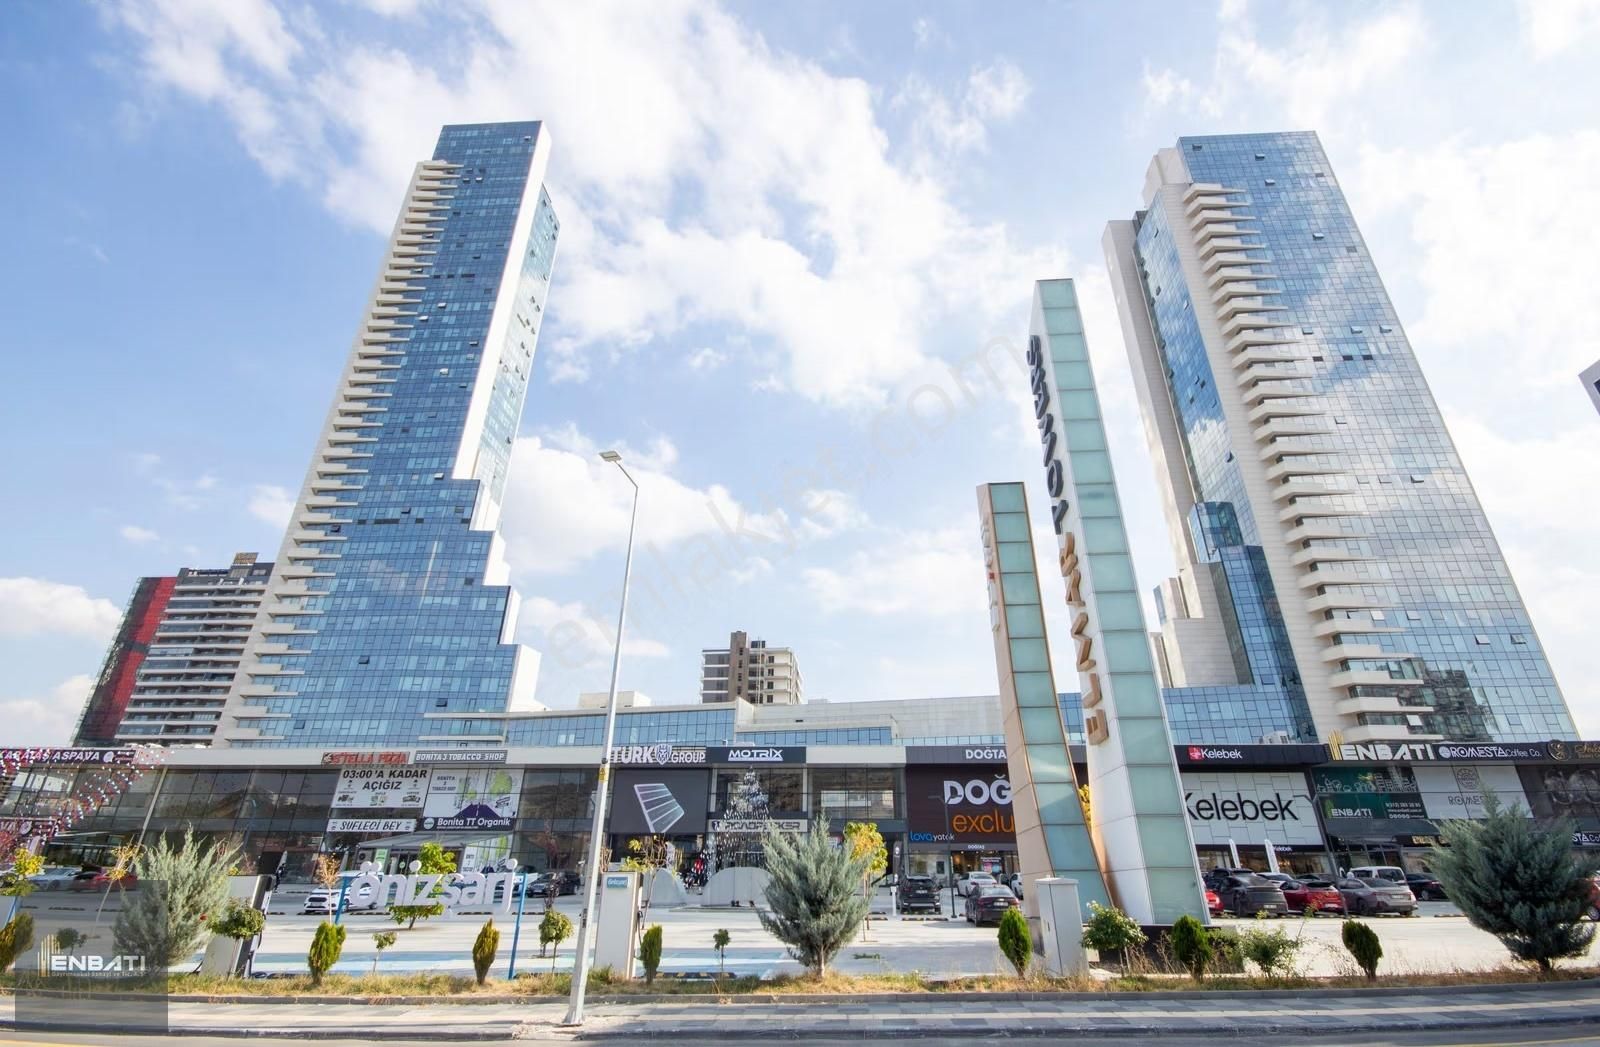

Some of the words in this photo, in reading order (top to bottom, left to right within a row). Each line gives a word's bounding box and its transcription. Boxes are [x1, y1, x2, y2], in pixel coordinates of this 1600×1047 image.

[1027, 334, 1069, 535] TOWERS
[1058, 531, 1109, 746] ELMAR
[52, 751, 100, 761] ASPAVA
[449, 753, 481, 761] TOBACCO
[484, 753, 505, 761] SHOP
[671, 751, 706, 763] GROUP
[965, 747, 1007, 759] DOĞTA
[1201, 748, 1243, 759] Kelebek
[1341, 743, 1435, 761] ENBATI
[388, 769, 428, 779] KADAR
[362, 779, 402, 792] AÇIĞIZ
[943, 774, 1012, 805] DOĞ
[1331, 808, 1372, 817] ENBATI
[382, 821, 402, 831] BEY
[437, 817, 464, 826] Bonita
[477, 817, 511, 828] Organik
[952, 808, 1016, 833] exclu
